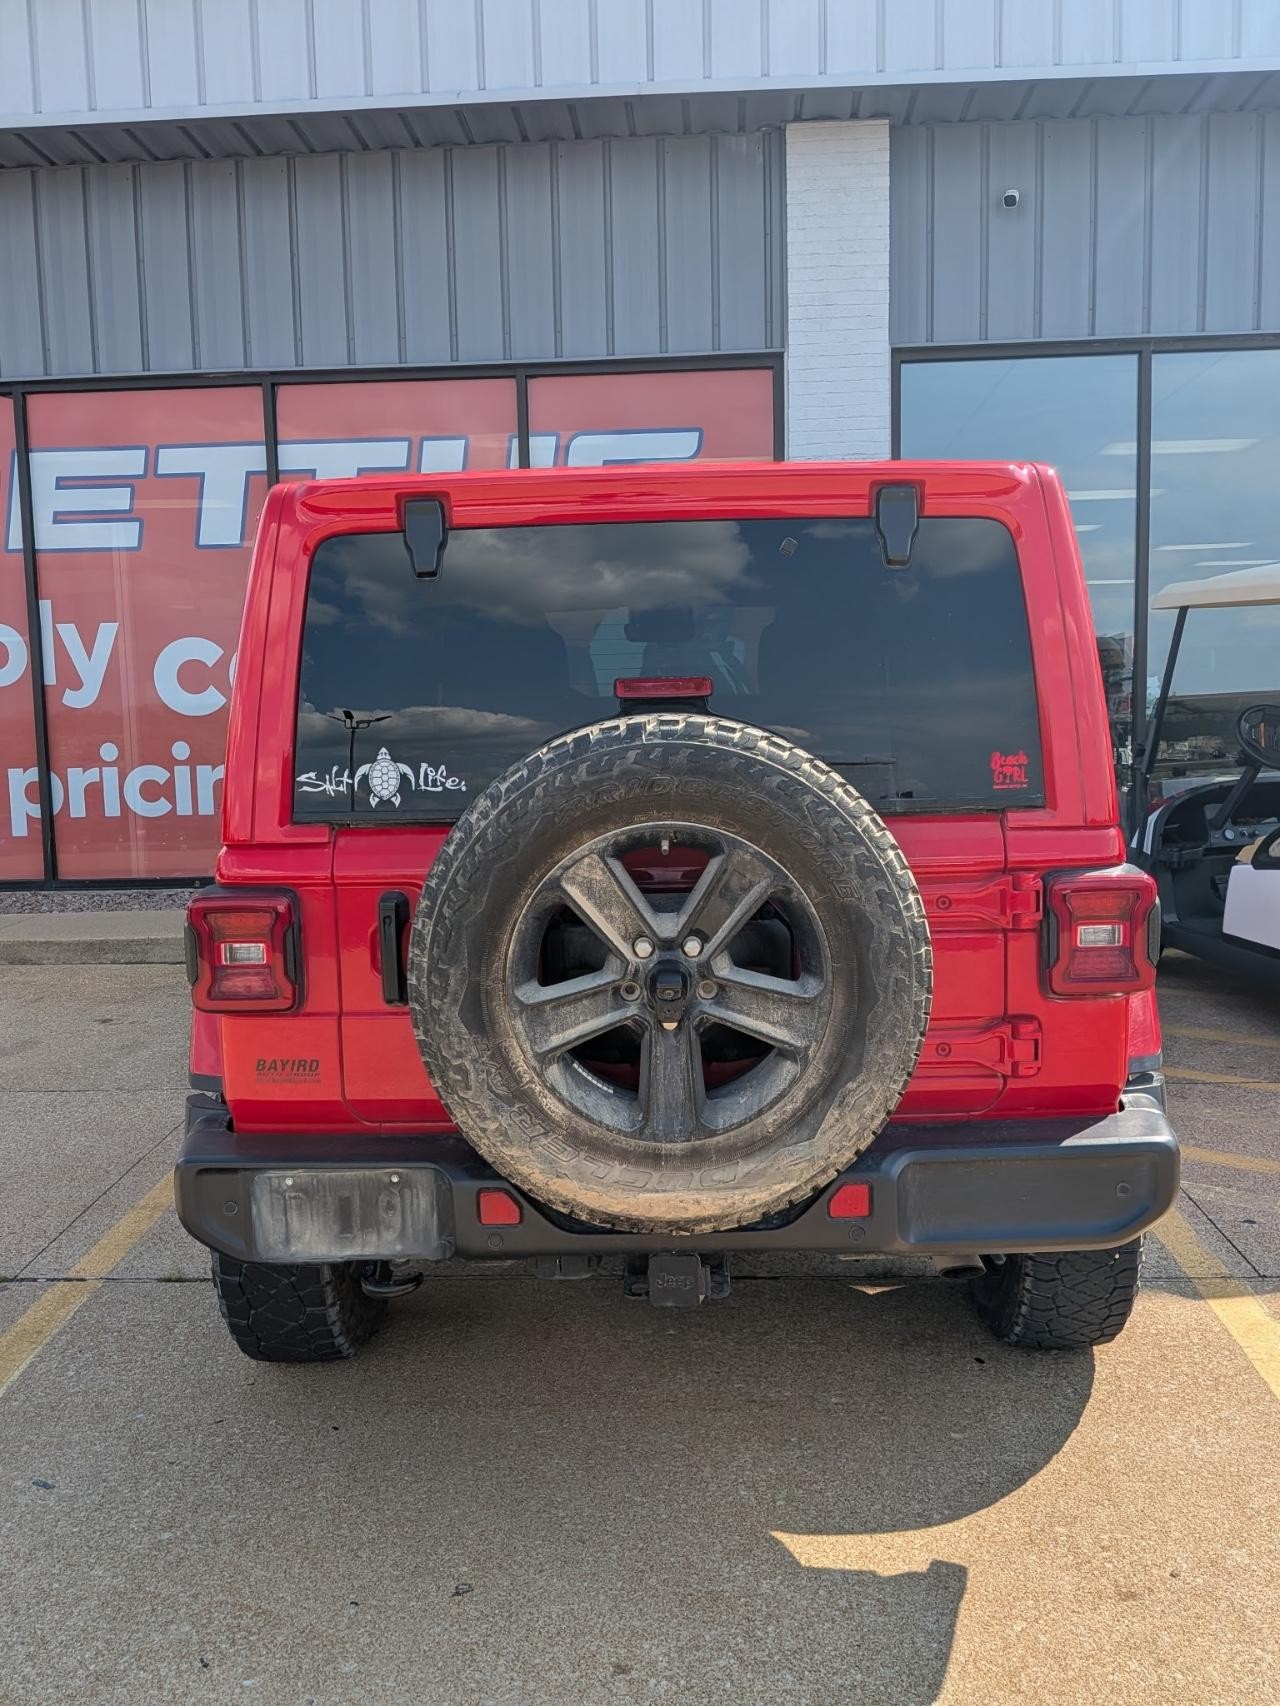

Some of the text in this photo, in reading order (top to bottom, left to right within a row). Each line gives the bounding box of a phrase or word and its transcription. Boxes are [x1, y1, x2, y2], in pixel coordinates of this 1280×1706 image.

[153, 636, 238, 717] c
[256, 1059, 320, 1072] BAYIRD
[656, 1272, 693, 1290] Jeep
